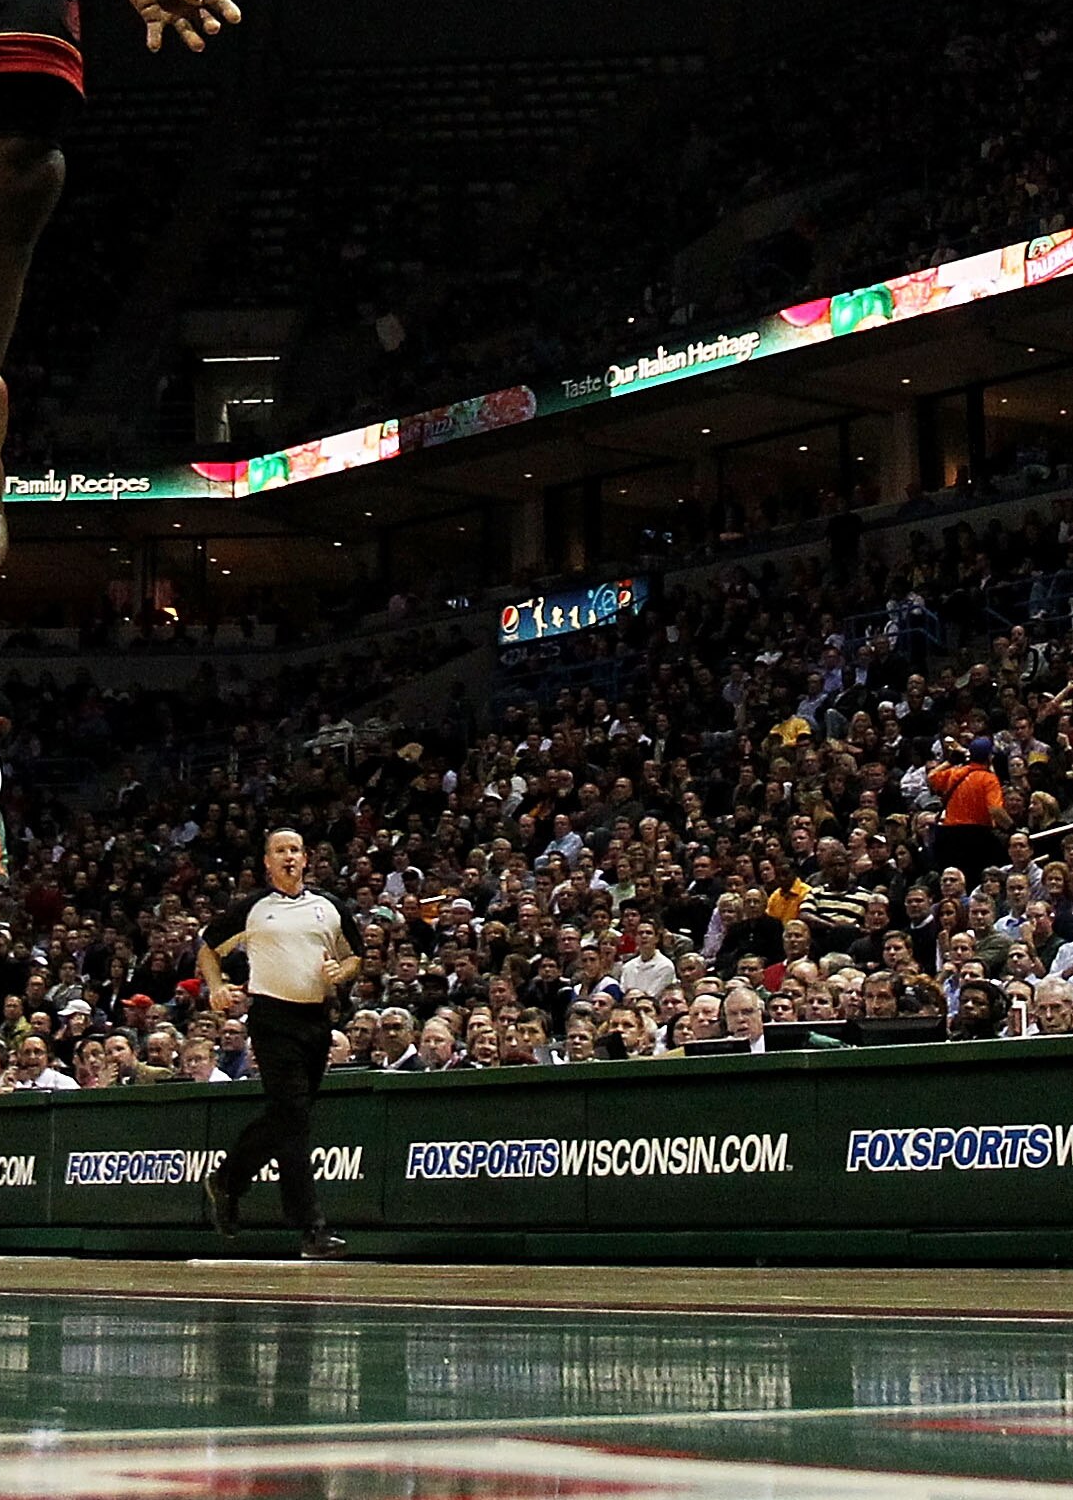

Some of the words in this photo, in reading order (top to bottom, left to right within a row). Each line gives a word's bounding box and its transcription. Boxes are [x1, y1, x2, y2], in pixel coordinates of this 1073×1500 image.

[561, 375, 601, 398] Taste
[604, 364, 638, 387] Our
[638, 345, 686, 379] Italian
[687, 331, 760, 362] Heritage
[5, 469, 66, 501] Family
[70, 473, 150, 500] Recipes
